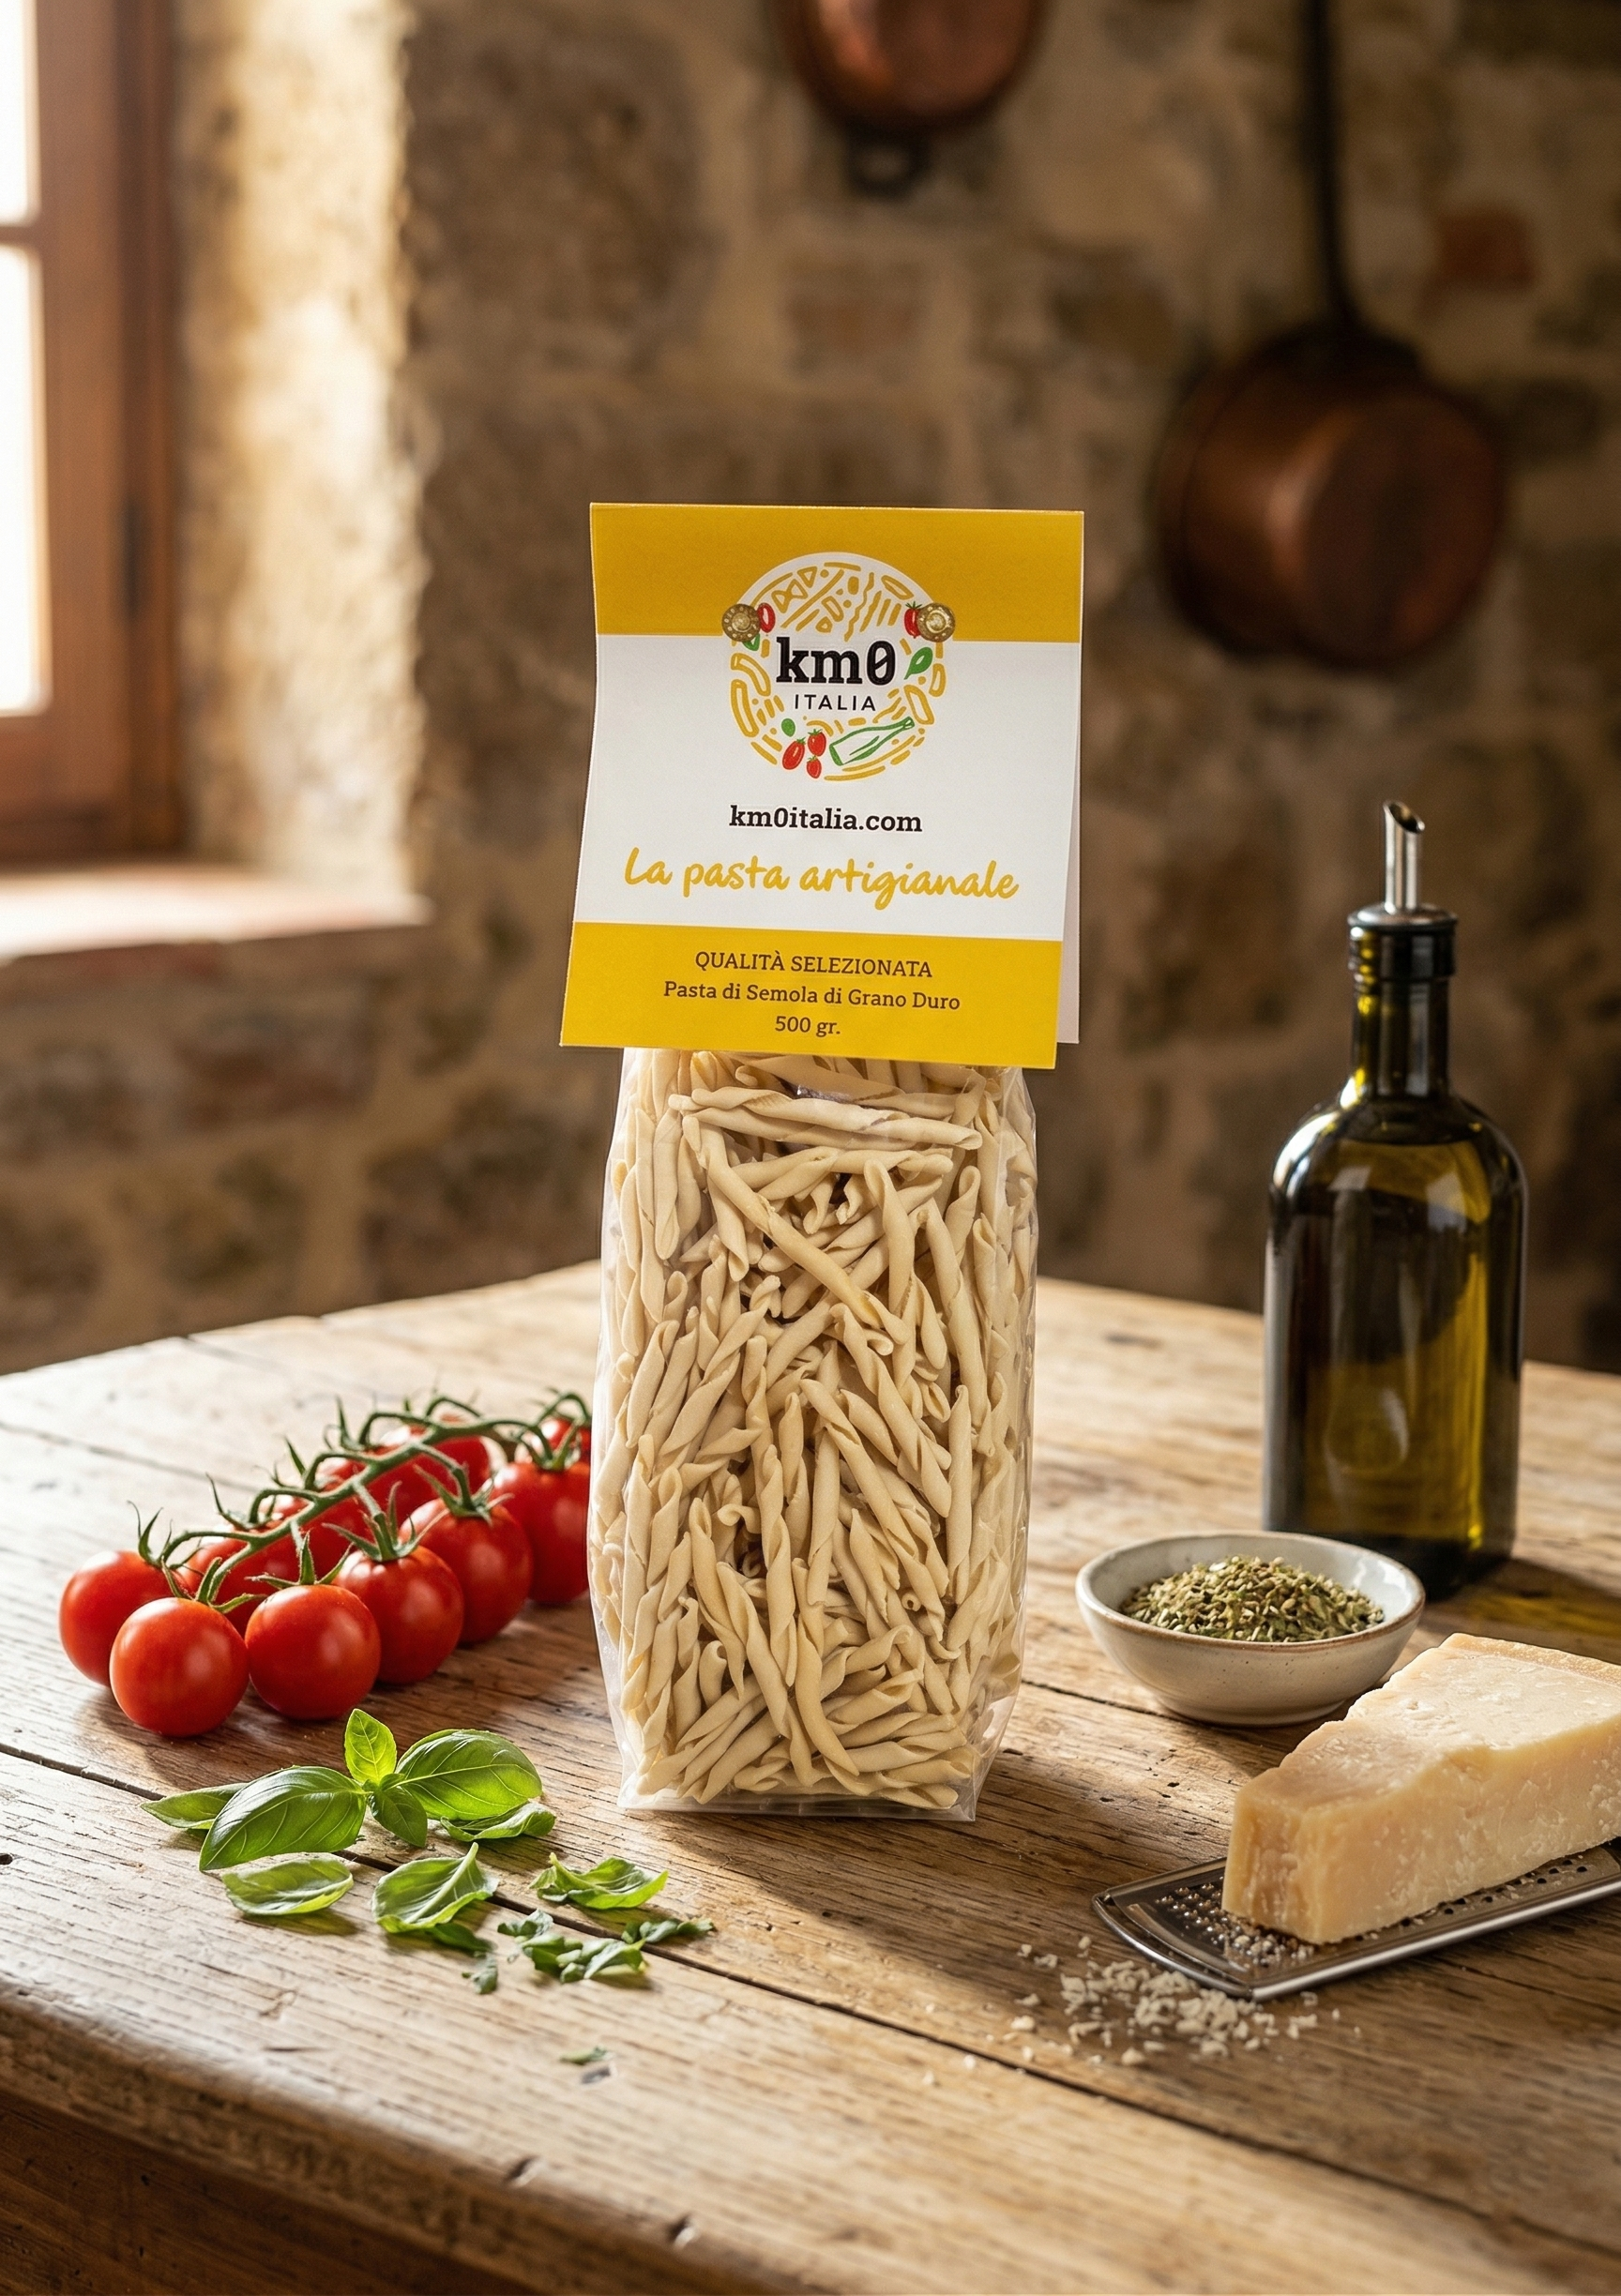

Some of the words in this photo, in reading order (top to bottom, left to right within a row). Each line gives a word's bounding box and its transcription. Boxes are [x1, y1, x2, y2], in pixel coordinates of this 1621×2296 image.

[775, 636, 896, 686] km0
[794, 693, 876, 712] ITALIA
[728, 805, 923, 833] km0italia.com
[624, 846, 674, 886] La
[682, 855, 790, 898] pasta
[799, 857, 1020, 911] artigianale
[694, 949, 786, 973] QUALITÀ
[790, 955, 933, 978] SELEZIONATA
[663, 980, 719, 1000] Pasta
[721, 983, 741, 1001] di
[746, 984, 819, 1004] Semola
[824, 987, 842, 1005] di
[847, 989, 907, 1008] Grano
[912, 990, 961, 1010] Duro
[774, 1016, 812, 1034] 500
[815, 1019, 841, 1037] gr.
